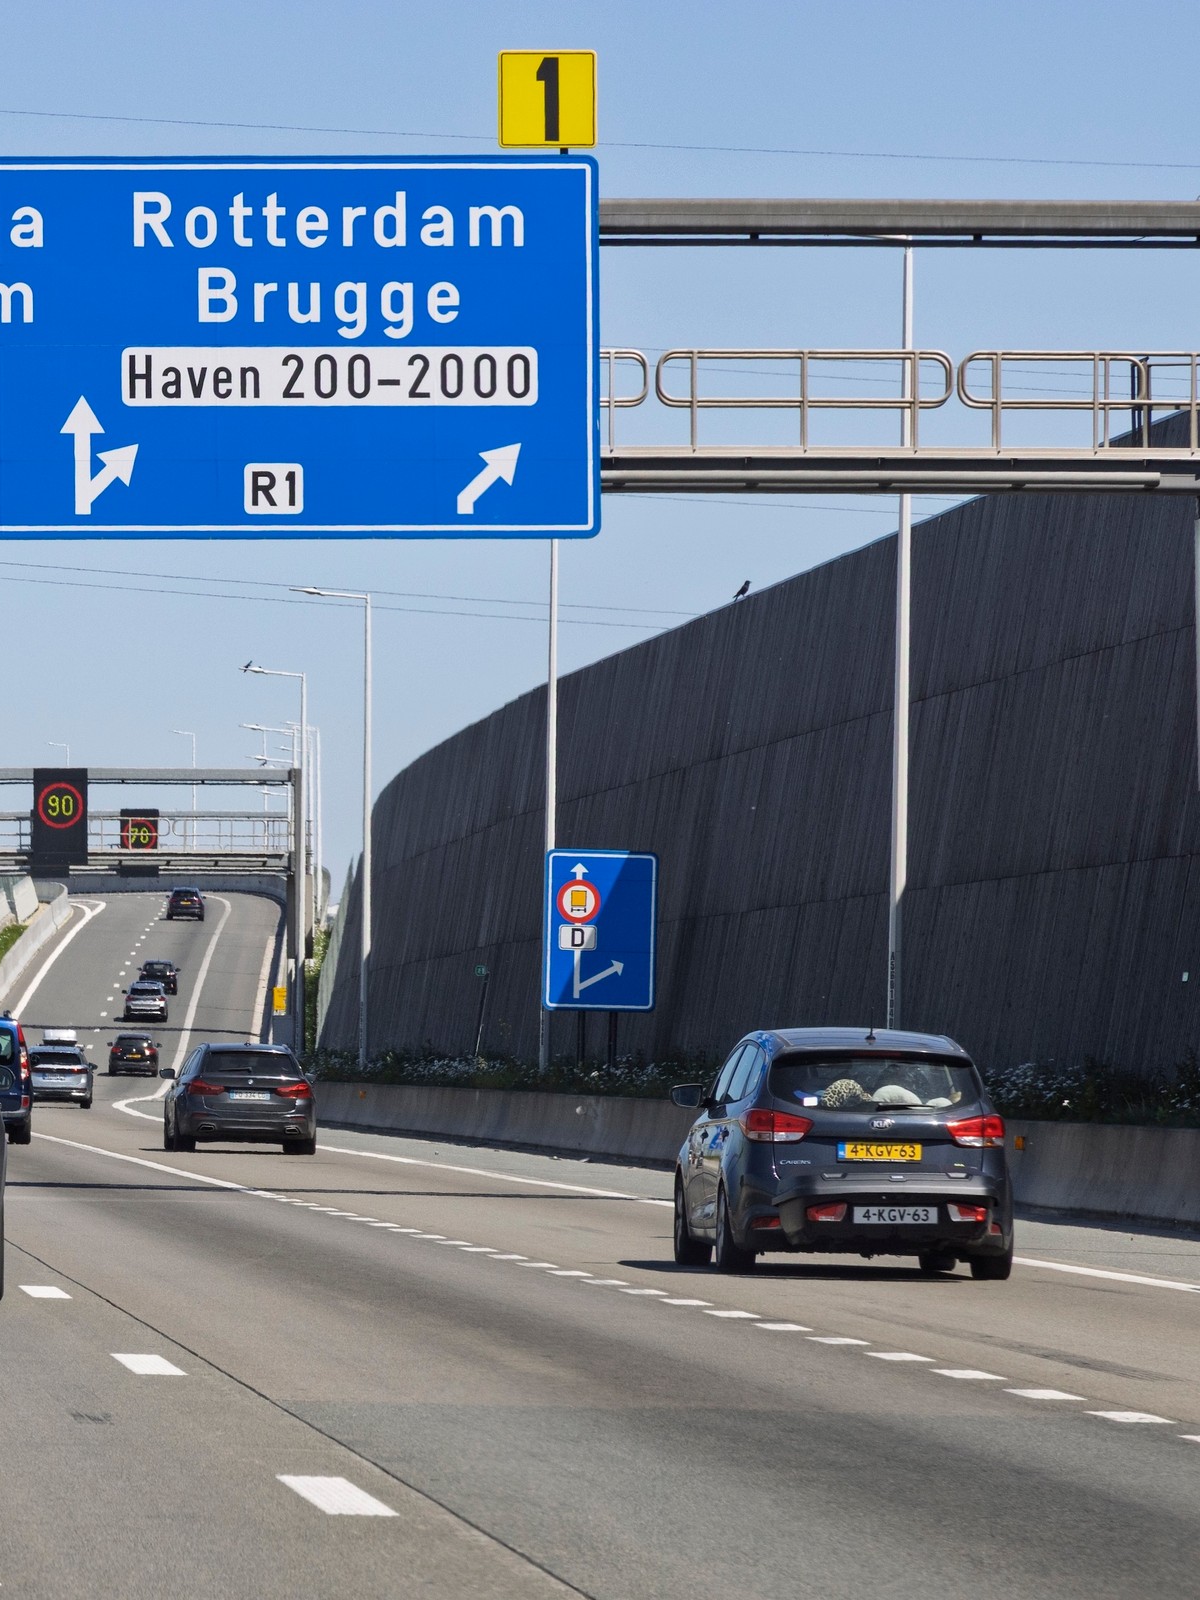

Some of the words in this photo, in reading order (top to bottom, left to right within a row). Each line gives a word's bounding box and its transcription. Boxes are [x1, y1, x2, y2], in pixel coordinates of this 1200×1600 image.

[536, 57, 560, 142] 1
[133, 191, 525, 249] Rotterdam
[197, 268, 461, 339] Brugge
[128, 354, 261, 399] Haven
[281, 353, 531, 399] 200-2000
[251, 470, 297, 507] R1
[48, 794, 74, 817] 90
[571, 928, 585, 947] D
[873, 1119, 890, 1128] KIA
[850, 1144, 916, 1158] 4-KGV-63
[862, 1208, 930, 1222] 4-KGV-63
